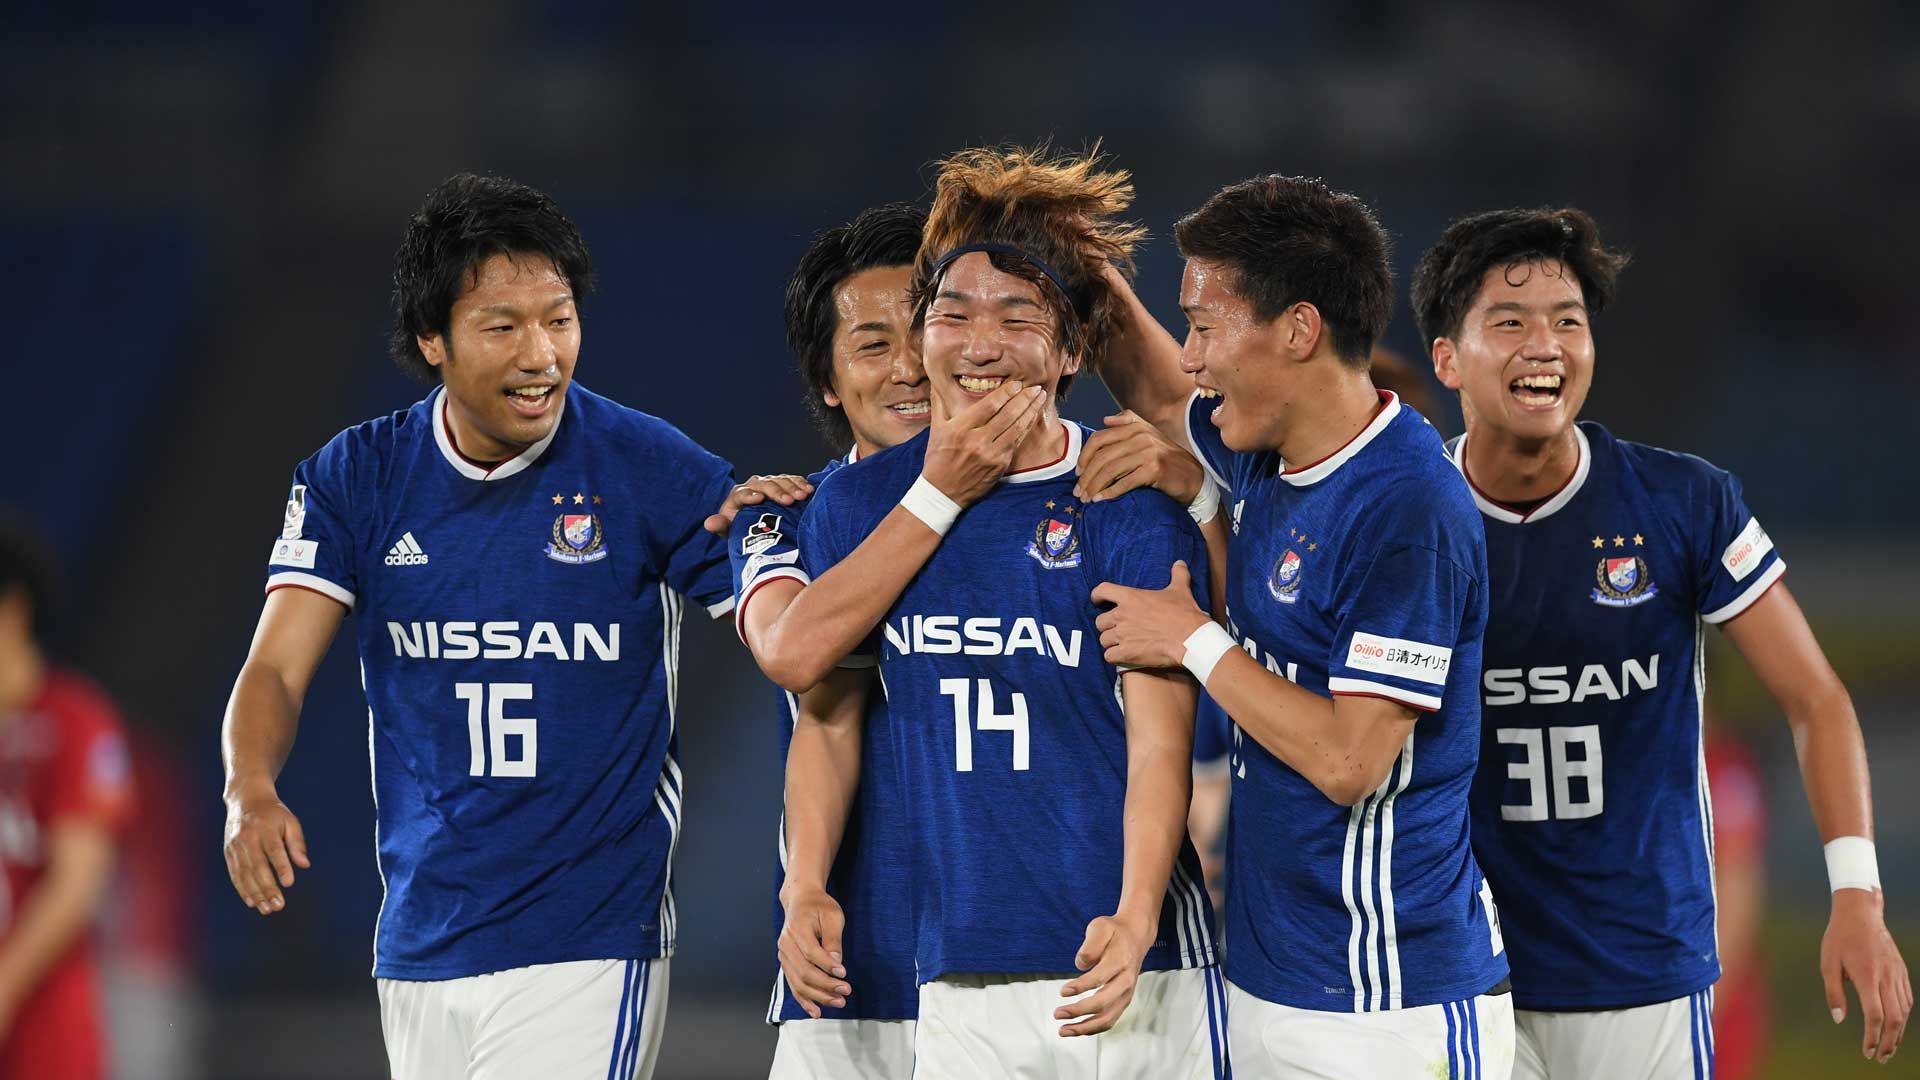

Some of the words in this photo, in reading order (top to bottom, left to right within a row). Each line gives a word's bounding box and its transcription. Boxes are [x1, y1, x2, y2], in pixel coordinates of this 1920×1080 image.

[384, 553, 429, 566] adidas
[387, 621, 620, 662] NISSAN
[884, 614, 1083, 668] NISSAN
[1385, 648, 1448, 671] 日清オイリオ
[1484, 653, 1660, 706] SSAN
[455, 682, 538, 778] 16
[939, 678, 1031, 773] 14
[1496, 724, 1604, 822] 38
